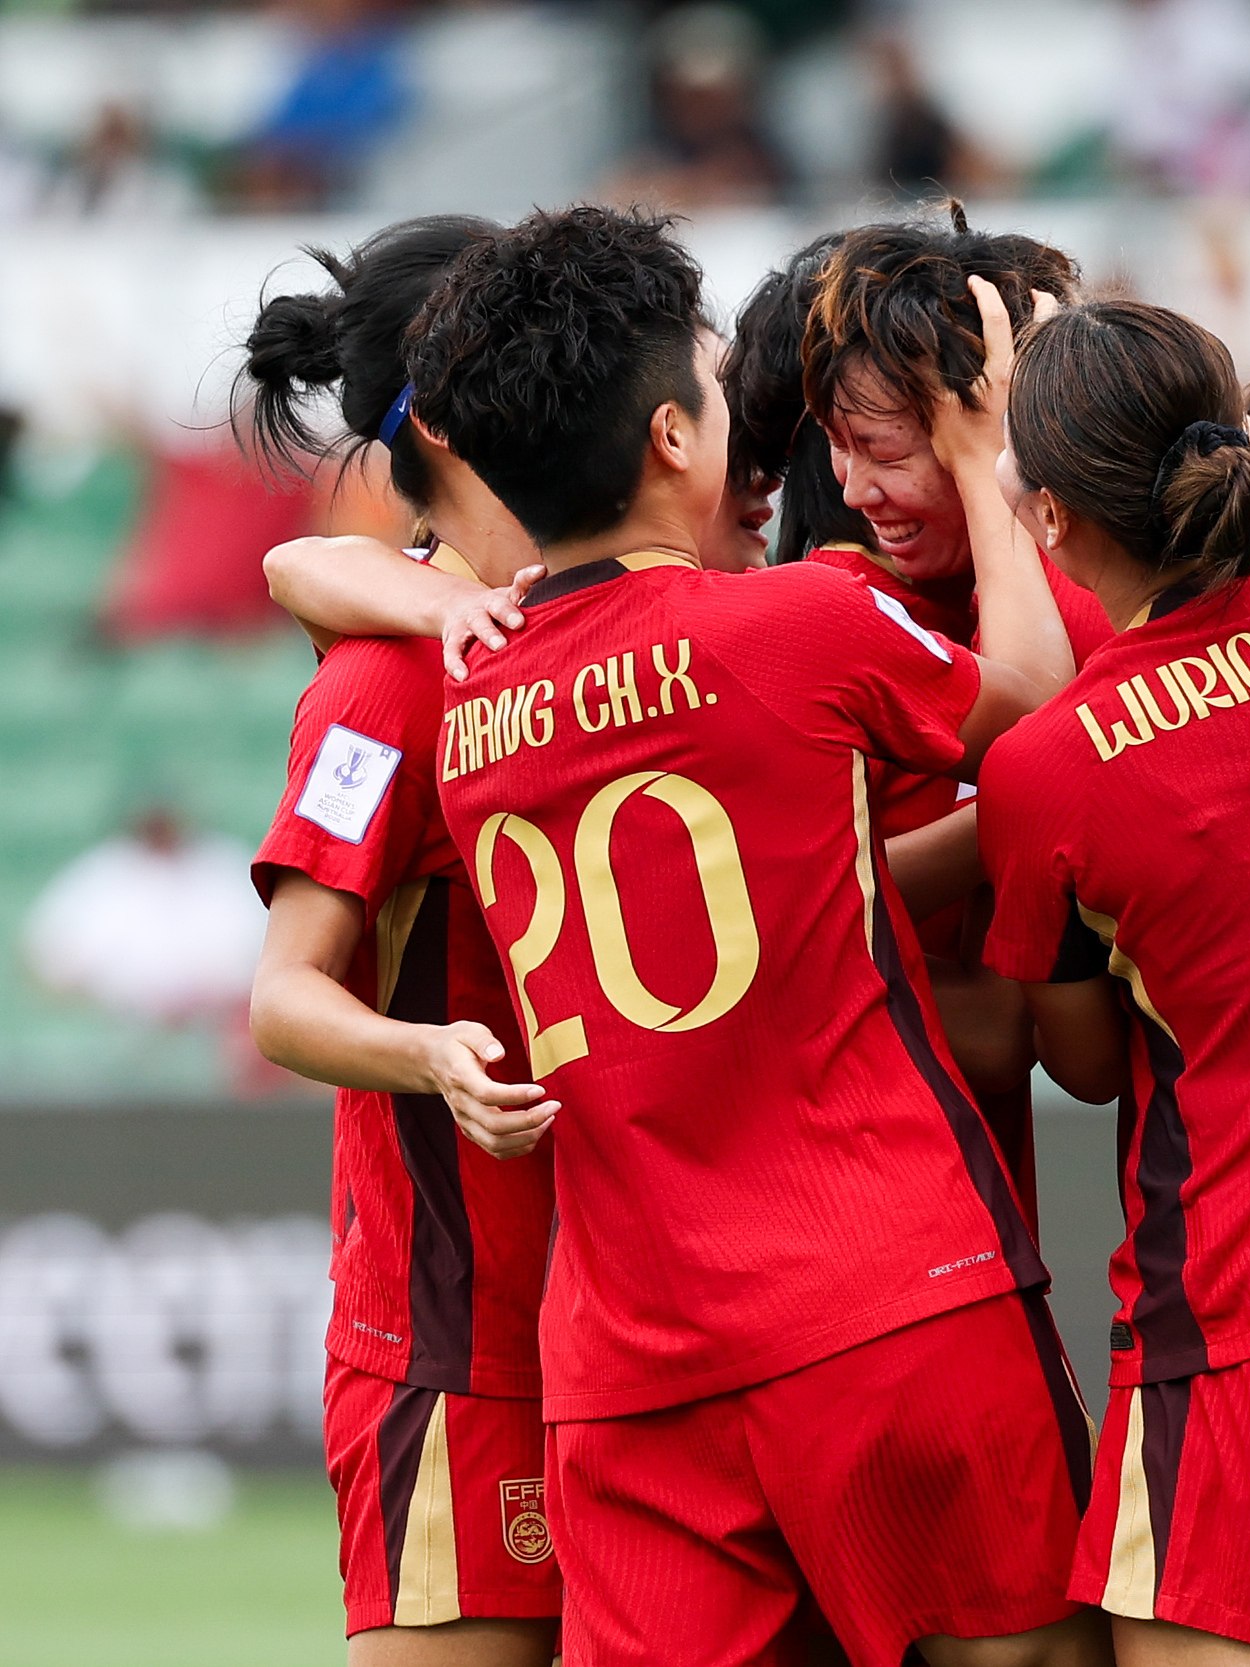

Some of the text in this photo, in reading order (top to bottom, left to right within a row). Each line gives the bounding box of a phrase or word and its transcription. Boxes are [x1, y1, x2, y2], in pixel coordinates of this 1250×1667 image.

[442, 638, 718, 783] ZHANG CH.X.
[474, 771, 760, 1081] 20
